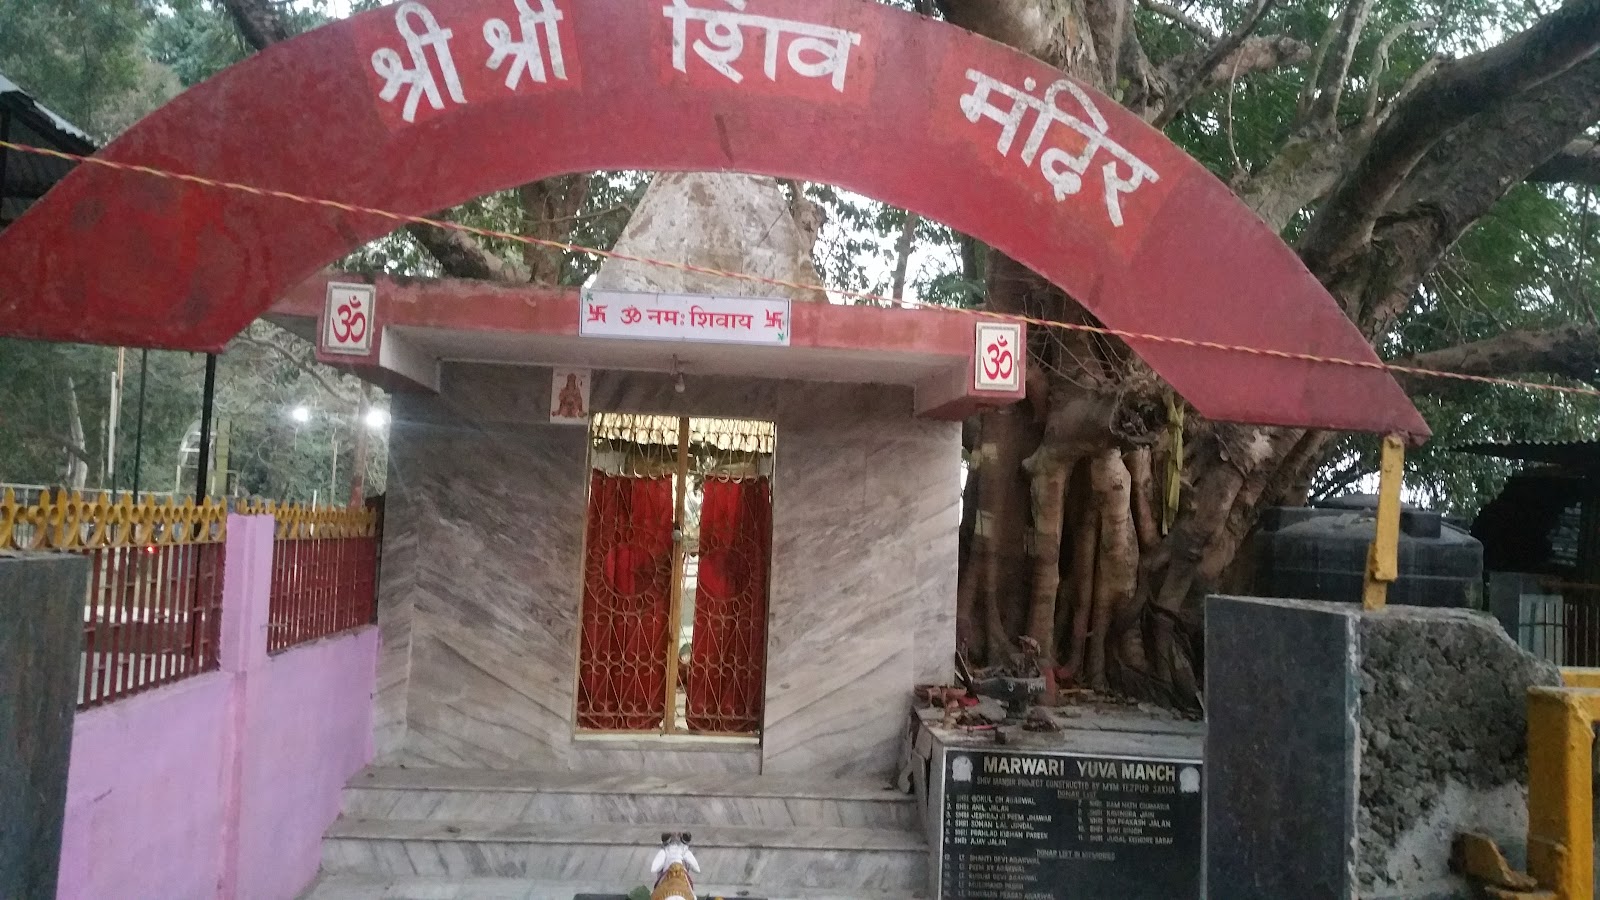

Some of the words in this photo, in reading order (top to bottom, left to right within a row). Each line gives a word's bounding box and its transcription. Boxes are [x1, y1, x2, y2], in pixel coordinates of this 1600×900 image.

[371, 2, 468, 123] श्री
[483, 0, 568, 91] श्री
[662, 0, 861, 93] शिव
[960, 68, 1160, 228] मंदिर
[689, 305, 754, 330] शिवाय
[983, 756, 1065, 776] MARWARI
[1077, 760, 1118, 779] YUVA
[1121, 763, 1176, 782] MANCH
[976, 776, 992, 785] SHIV
[1018, 778, 1043, 788] PROJECT
[1046, 779, 1089, 790] CONSTRUCTED
[1092, 781, 1100, 791] BY
[1122, 783, 1149, 793] TEZPUR
[1153, 785, 1176, 795] SAKHA
[956, 802, 969, 810] SHRI
[971, 803, 986, 811] ANIL
[988, 804, 1009, 812] JALAN
[955, 811, 969, 819] SHRI
[954, 820, 969, 828] SHRI
[1118, 818, 1146, 827] PRAKASH
[1149, 819, 1171, 828] JALAN
[954, 837, 967, 845] SHRI
[970, 837, 985, 846] AJAY
[987, 838, 1007, 846] JALAN
